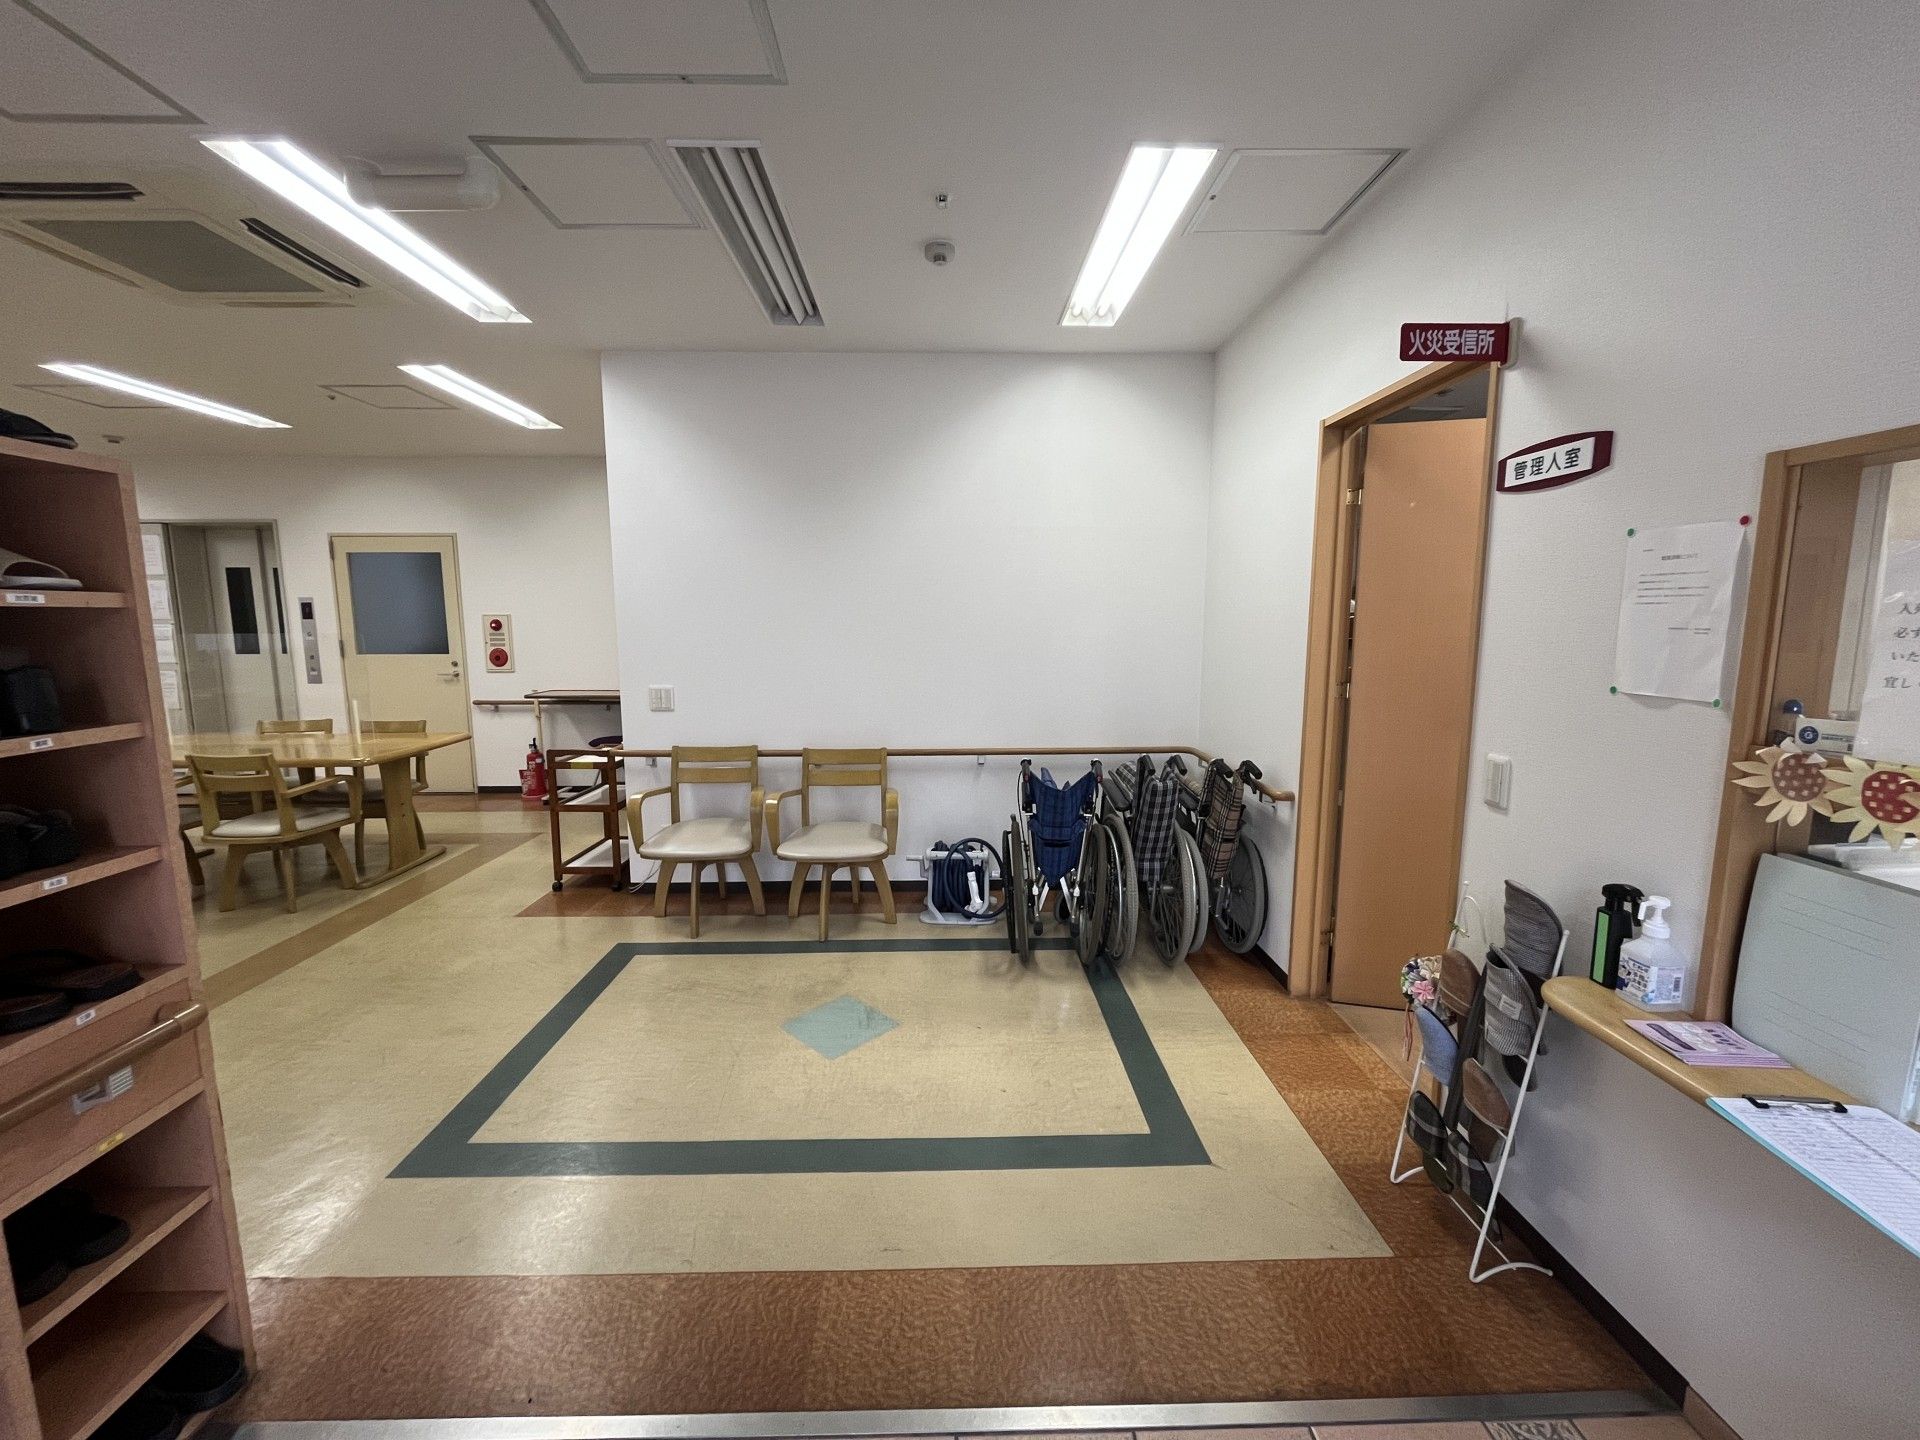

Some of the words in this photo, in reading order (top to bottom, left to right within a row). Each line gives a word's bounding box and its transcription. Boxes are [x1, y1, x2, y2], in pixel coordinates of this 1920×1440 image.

[1408, 329, 1495, 355] 火災受信所
[1514, 447, 1580, 480] 管理人室
